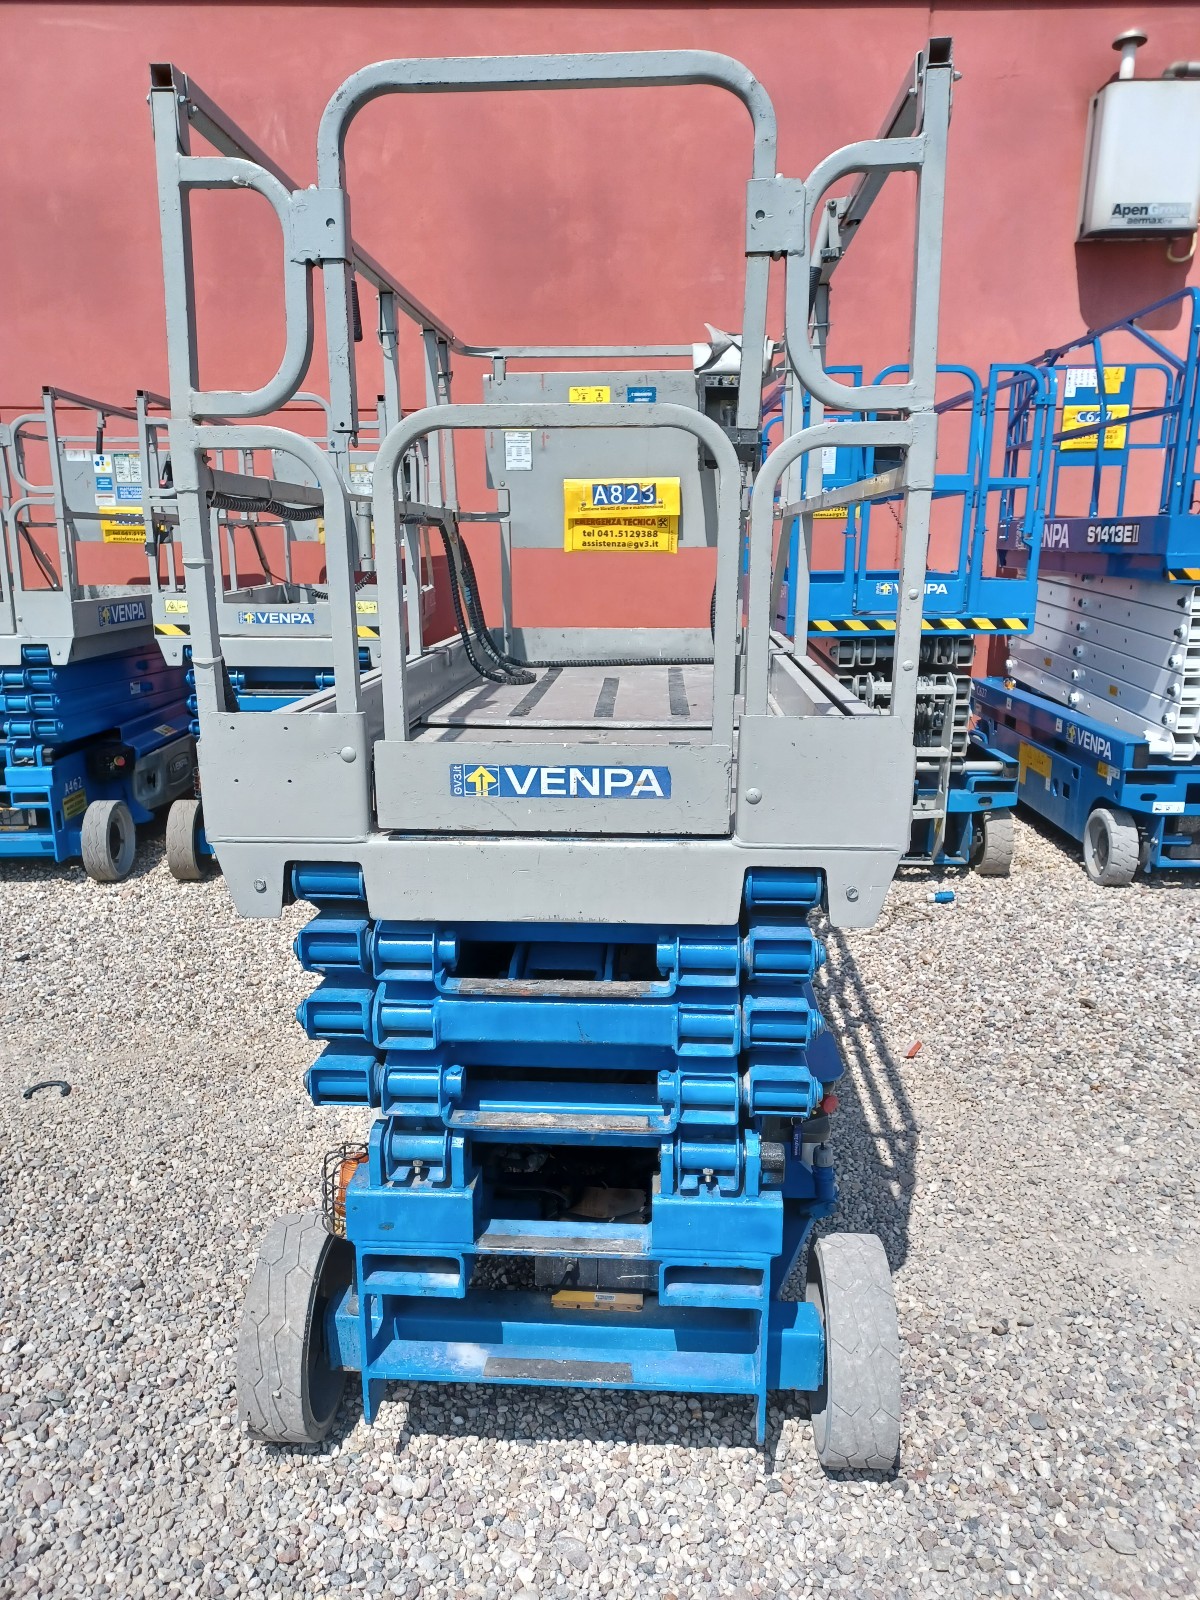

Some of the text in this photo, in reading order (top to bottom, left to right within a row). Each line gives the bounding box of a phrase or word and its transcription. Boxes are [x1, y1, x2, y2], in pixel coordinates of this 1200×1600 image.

[593, 484, 654, 505] A823
[575, 518, 656, 526] EMERGENZA TECNICA
[582, 529, 658, 538] tel 041.5129388
[1041, 523, 1069, 549] NPA
[582, 540, 658, 549] assistenza@gv3.it
[111, 602, 145, 623] VENPA
[257, 613, 312, 624] VENPA
[1077, 728, 1112, 761] VENPA
[64, 776, 82, 795] A462
[453, 765, 664, 797] GV3.it VENPA
